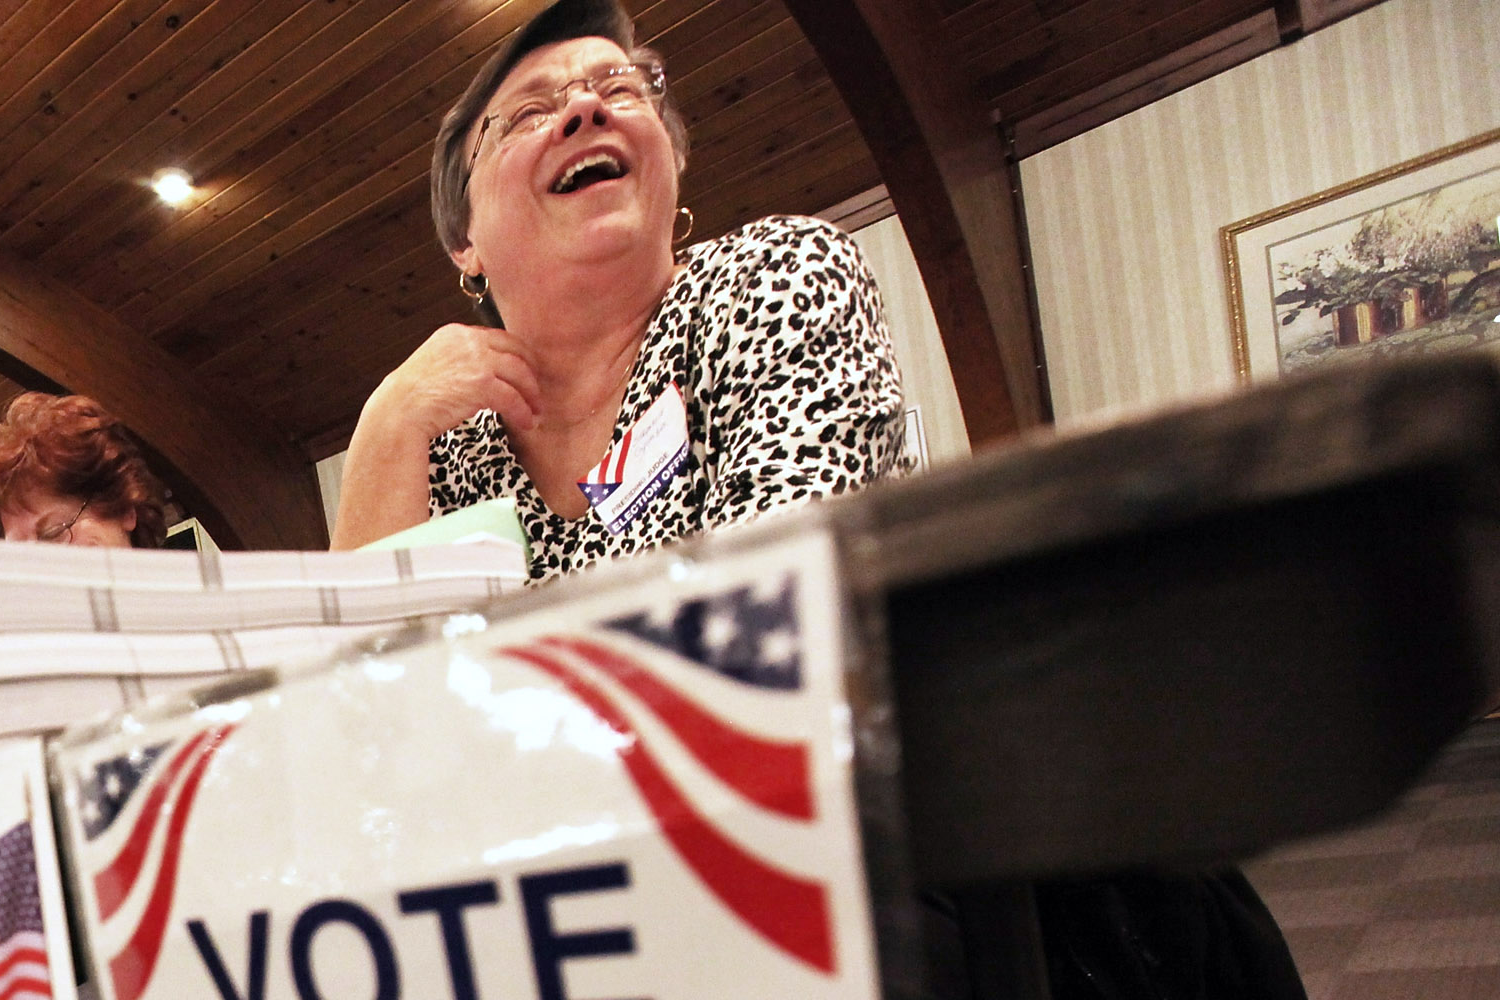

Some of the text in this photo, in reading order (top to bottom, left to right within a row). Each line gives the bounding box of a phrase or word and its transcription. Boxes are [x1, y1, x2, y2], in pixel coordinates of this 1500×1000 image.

[612, 481, 661, 532] ELECTION
[661, 441, 689, 481] OFFIC
[647, 452, 669, 477] JUDGE
